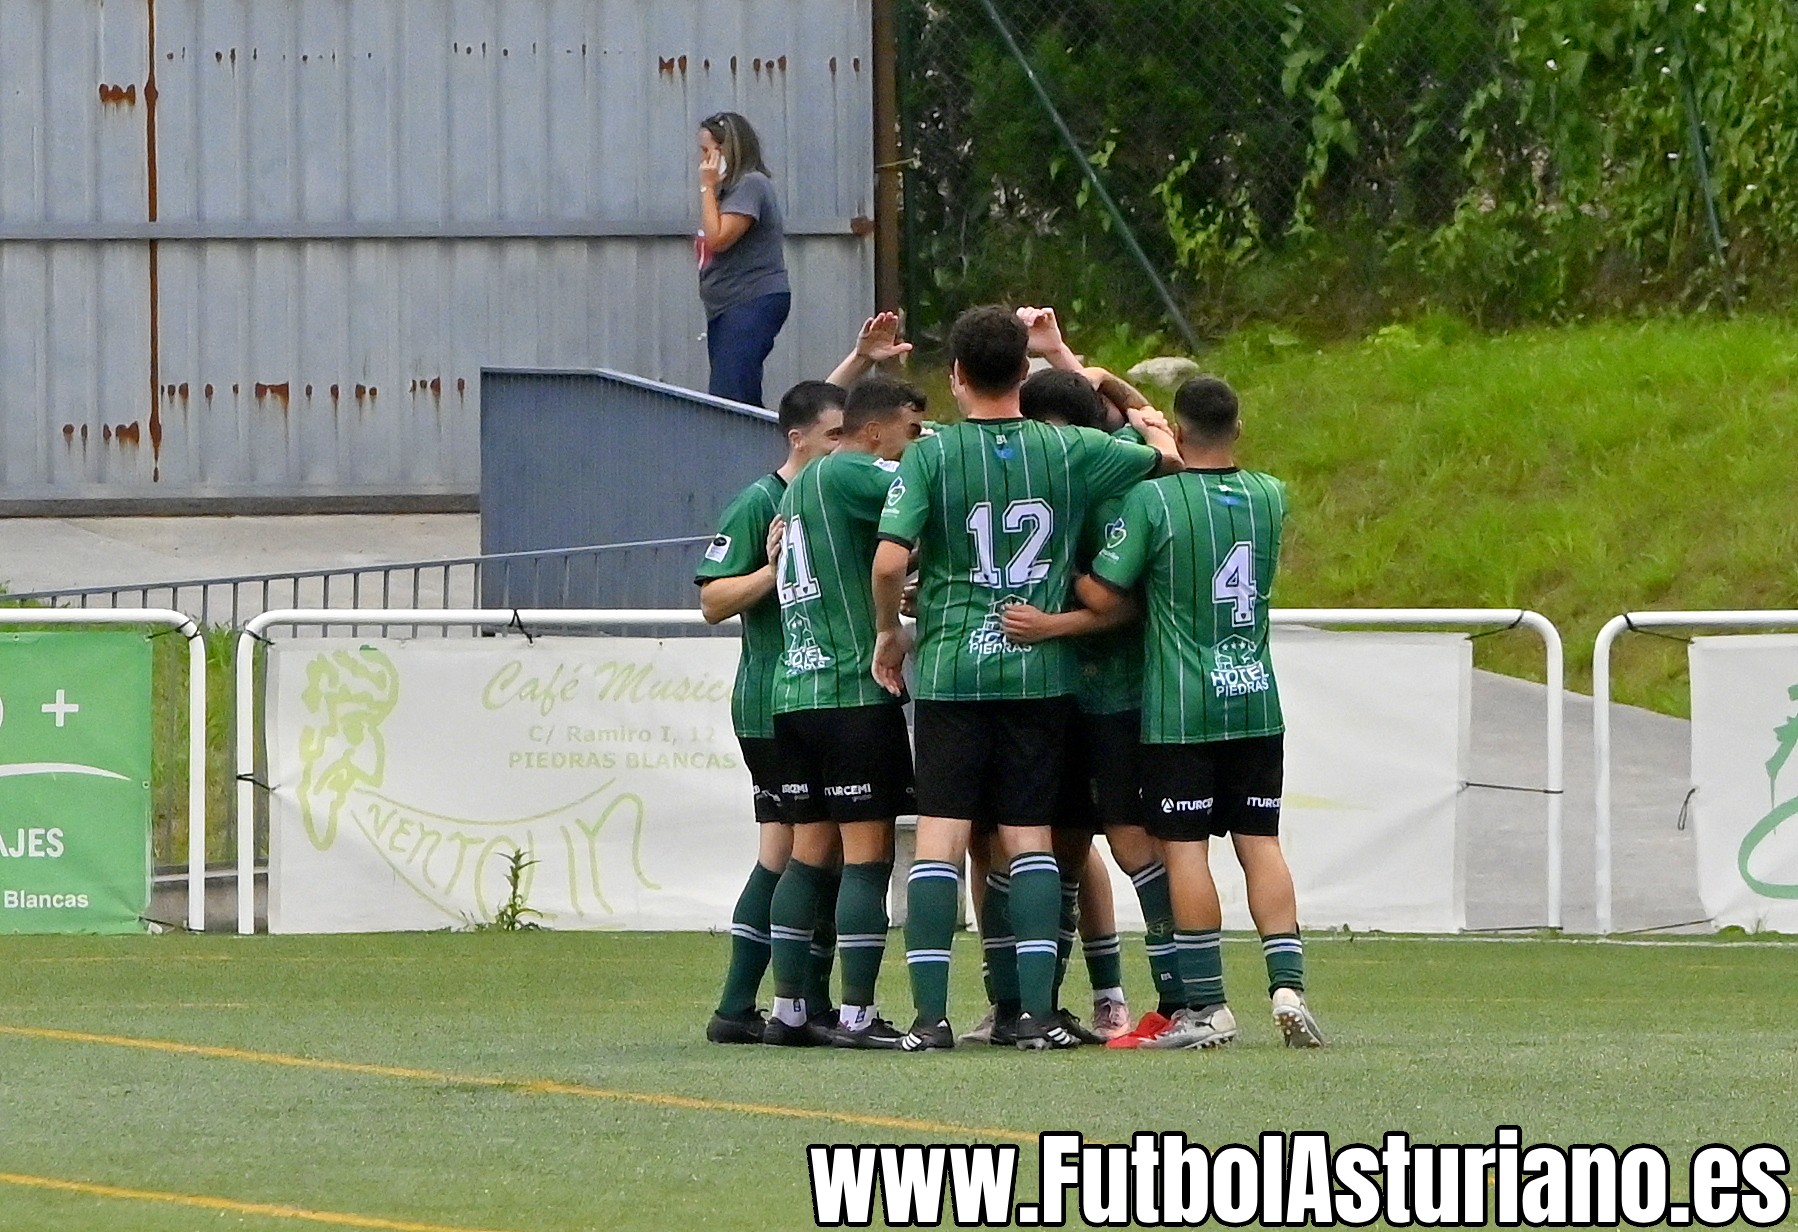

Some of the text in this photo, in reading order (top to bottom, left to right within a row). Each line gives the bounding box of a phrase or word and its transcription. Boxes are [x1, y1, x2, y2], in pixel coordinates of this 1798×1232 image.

[966, 497, 1054, 589] 12
[1212, 540, 1257, 628] 4
[1211, 661, 1270, 686] HOTEL
[482, 659, 733, 717] Café Music
[1216, 679, 1269, 698] PIEDRAS
[567, 725, 652, 743] Ramiro
[508, 752, 737, 769] PIEDRAS BLANCAS
[3, 890, 89, 909] Blancas
